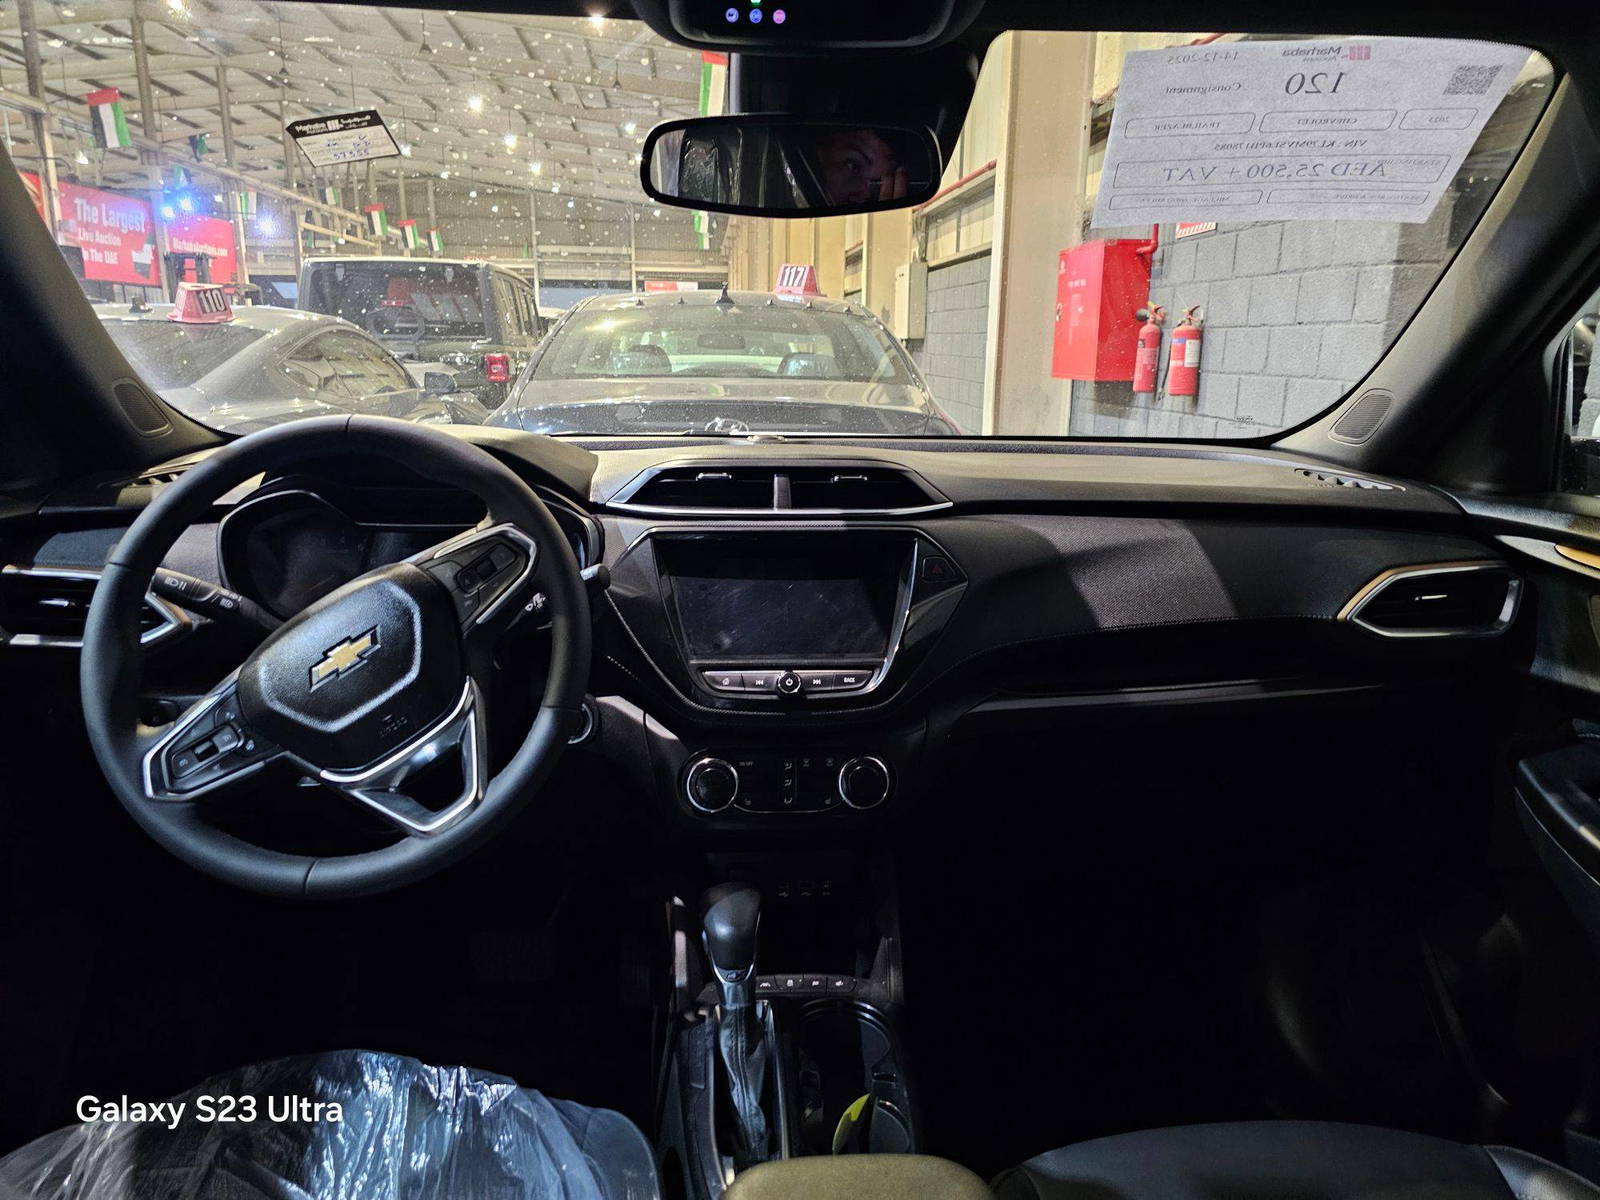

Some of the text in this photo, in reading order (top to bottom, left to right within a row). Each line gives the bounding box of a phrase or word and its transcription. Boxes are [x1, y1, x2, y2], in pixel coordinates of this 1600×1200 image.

[74, 197, 145, 233] The Largest
[78, 227, 122, 246] Live Auction
[90, 249, 104, 263] The
[104, 251, 119, 265] UAE
[783, 266, 805, 287] 117
[199, 289, 225, 314] 110
